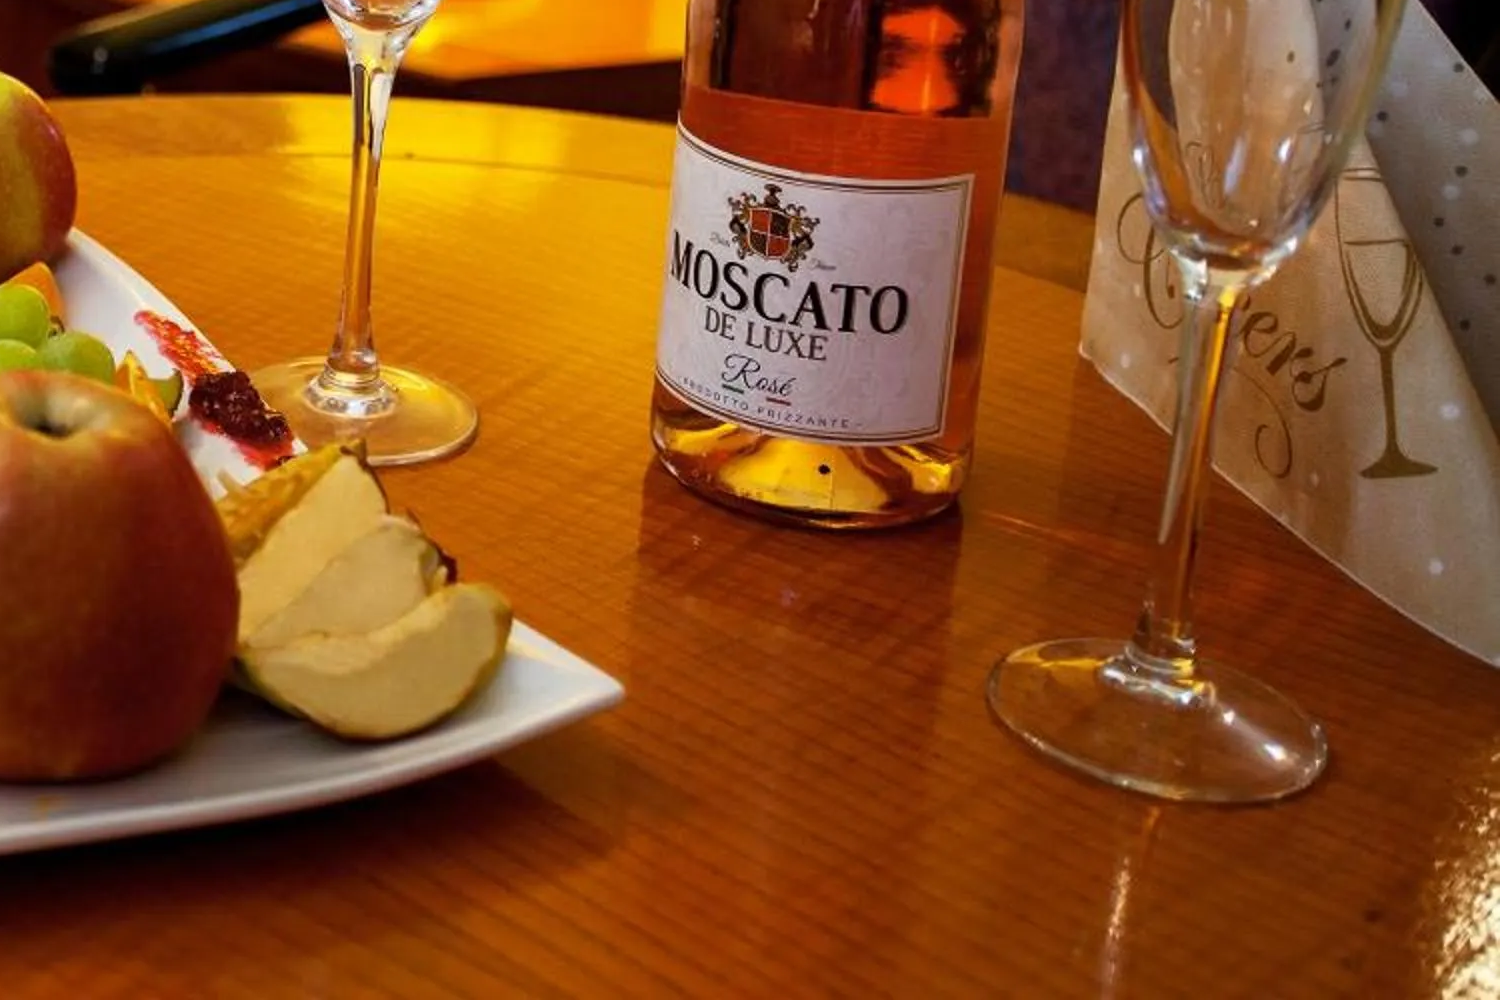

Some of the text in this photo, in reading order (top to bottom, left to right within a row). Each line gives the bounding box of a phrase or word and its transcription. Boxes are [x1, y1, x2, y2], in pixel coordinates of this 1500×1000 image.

[671, 229, 908, 335] MOSCATO
[705, 304, 828, 361] DE LUXE
[721, 353, 797, 398] Rosé
[757, 407, 850, 429] FRIZZANTE
